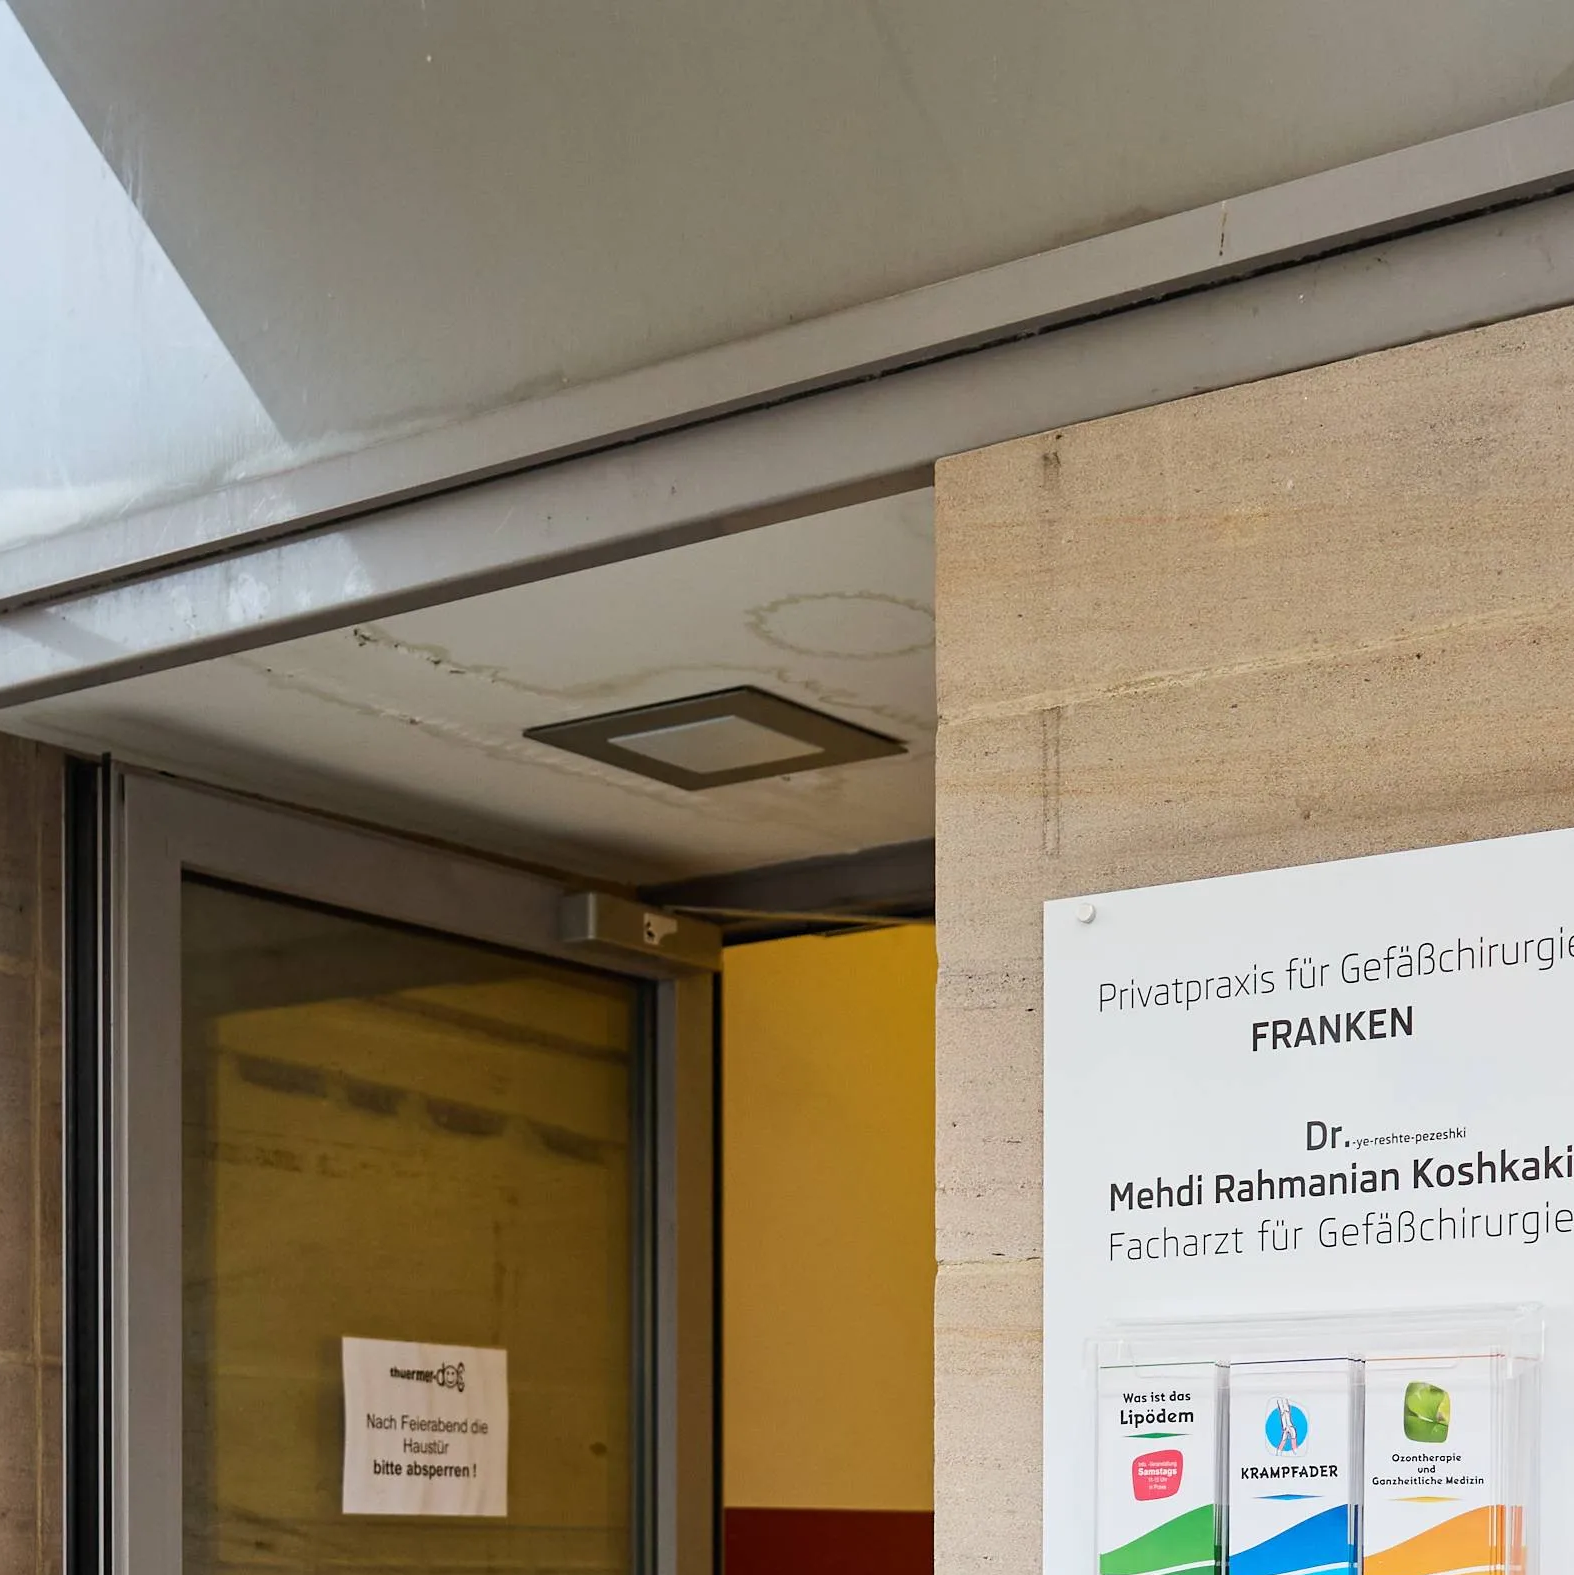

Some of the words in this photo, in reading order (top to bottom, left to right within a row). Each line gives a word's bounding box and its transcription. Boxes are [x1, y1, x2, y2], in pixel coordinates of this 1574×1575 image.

[1098, 962, 1275, 1012] Privatpraxis
[1286, 957, 1329, 992] für
[1251, 1005, 1413, 1052] FRANKEN
[1306, 1121, 1350, 1150] Dr.
[1109, 1174, 1203, 1212] Mehdi
[1215, 1161, 1400, 1205] Rahmanian
[1412, 1145, 1574, 1189] Koshkaki
[1109, 1225, 1244, 1262] Facharzt
[1258, 1219, 1303, 1252] für
[1318, 1203, 1574, 1250] Gefäßchirurgie
[1123, 1393, 1147, 1403] Was
[1150, 1392, 1165, 1402] ist
[1169, 1391, 1191, 1401] das
[367, 1413, 397, 1430] Nach
[401, 1415, 467, 1434] Feierabend
[471, 1420, 488, 1434] die
[1120, 1409, 1194, 1428] Lipödem
[403, 1438, 449, 1454] Haustür
[1392, 1453, 1461, 1463] Ozontherapie
[373, 1460, 402, 1476] bitte
[406, 1461, 469, 1479] absperren
[1138, 1468, 1177, 1477] Samstags
[1241, 1465, 1338, 1480] KRAMPFADER
[1417, 1465, 1436, 1473] und
[1372, 1477, 1443, 1485] Ganzheitliche
[1446, 1476, 1484, 1485] Medizin
